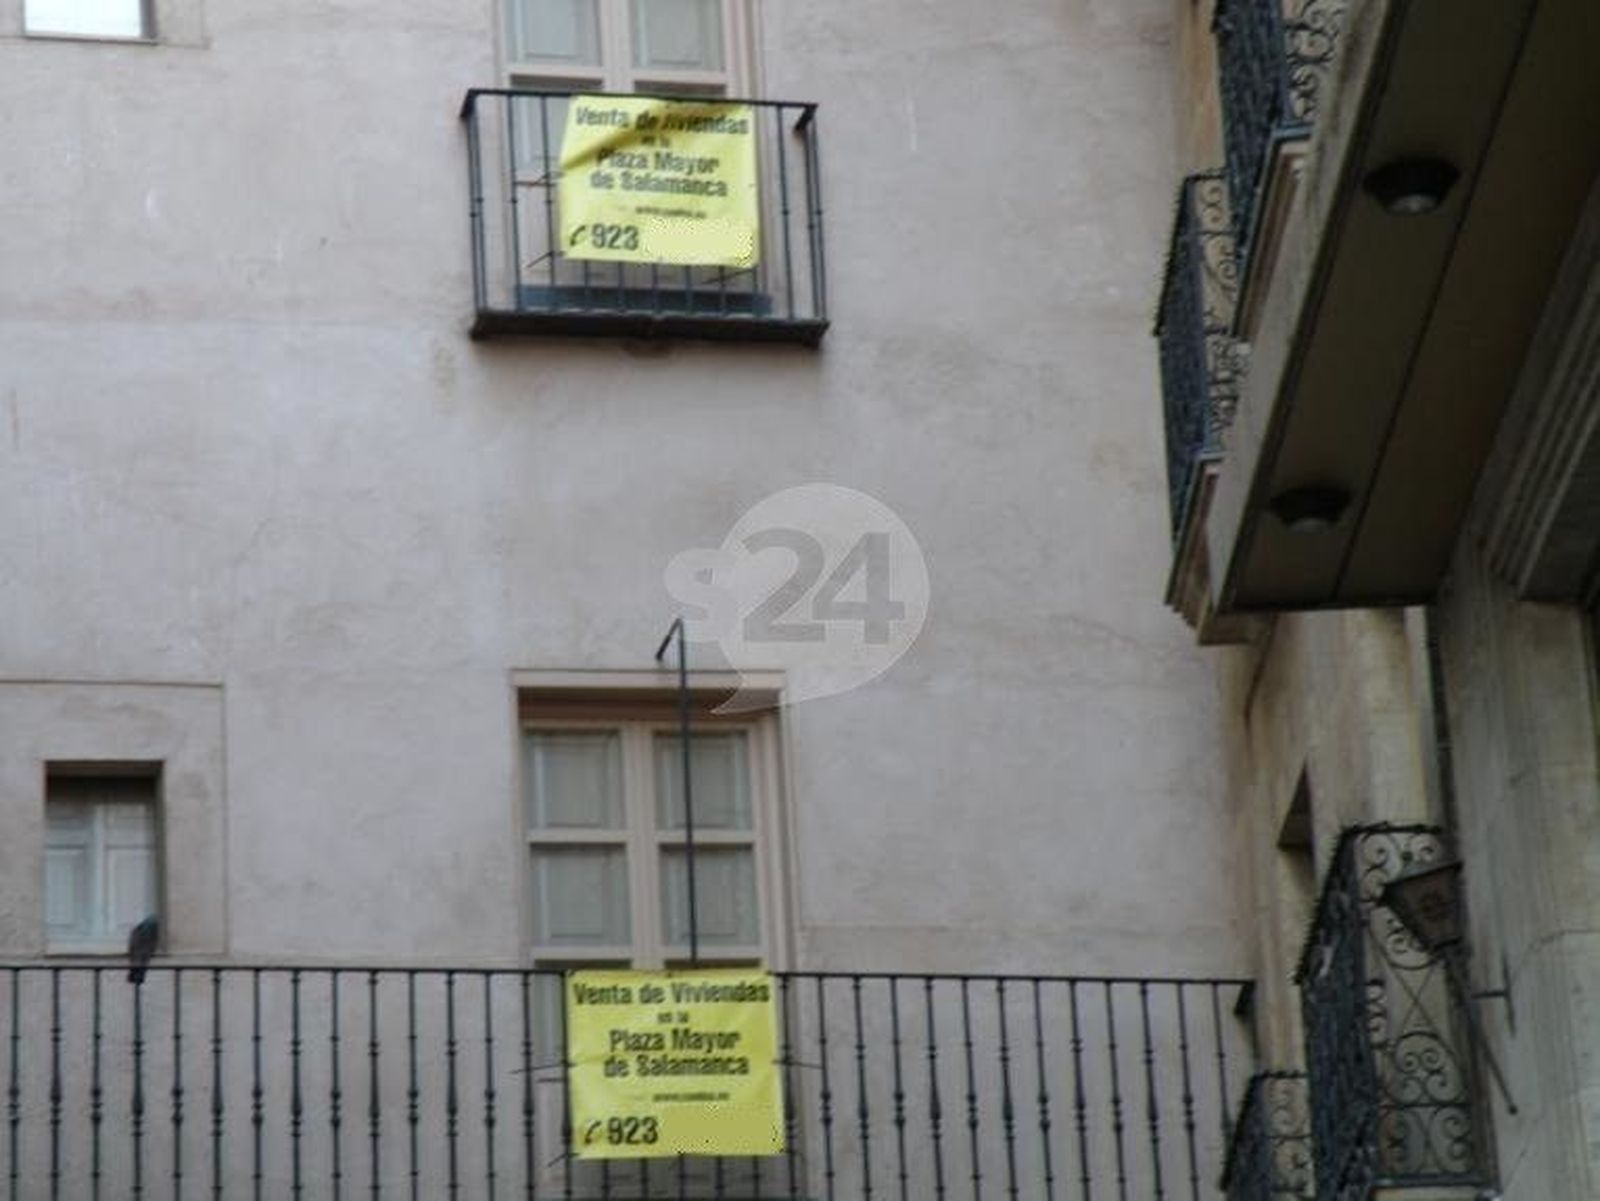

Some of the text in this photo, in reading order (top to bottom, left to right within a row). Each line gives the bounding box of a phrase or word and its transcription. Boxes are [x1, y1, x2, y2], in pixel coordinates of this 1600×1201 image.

[576, 107, 629, 127] Venta
[596, 147, 720, 175] Plaza Mayor
[590, 172, 729, 197] de Salamanca
[591, 223, 640, 251] 923
[573, 981, 770, 1005] Venta de Viviendas
[609, 1028, 740, 1053] Plaza Mayor
[603, 1053, 751, 1078] de Salamanca
[607, 1116, 659, 1145] 923
